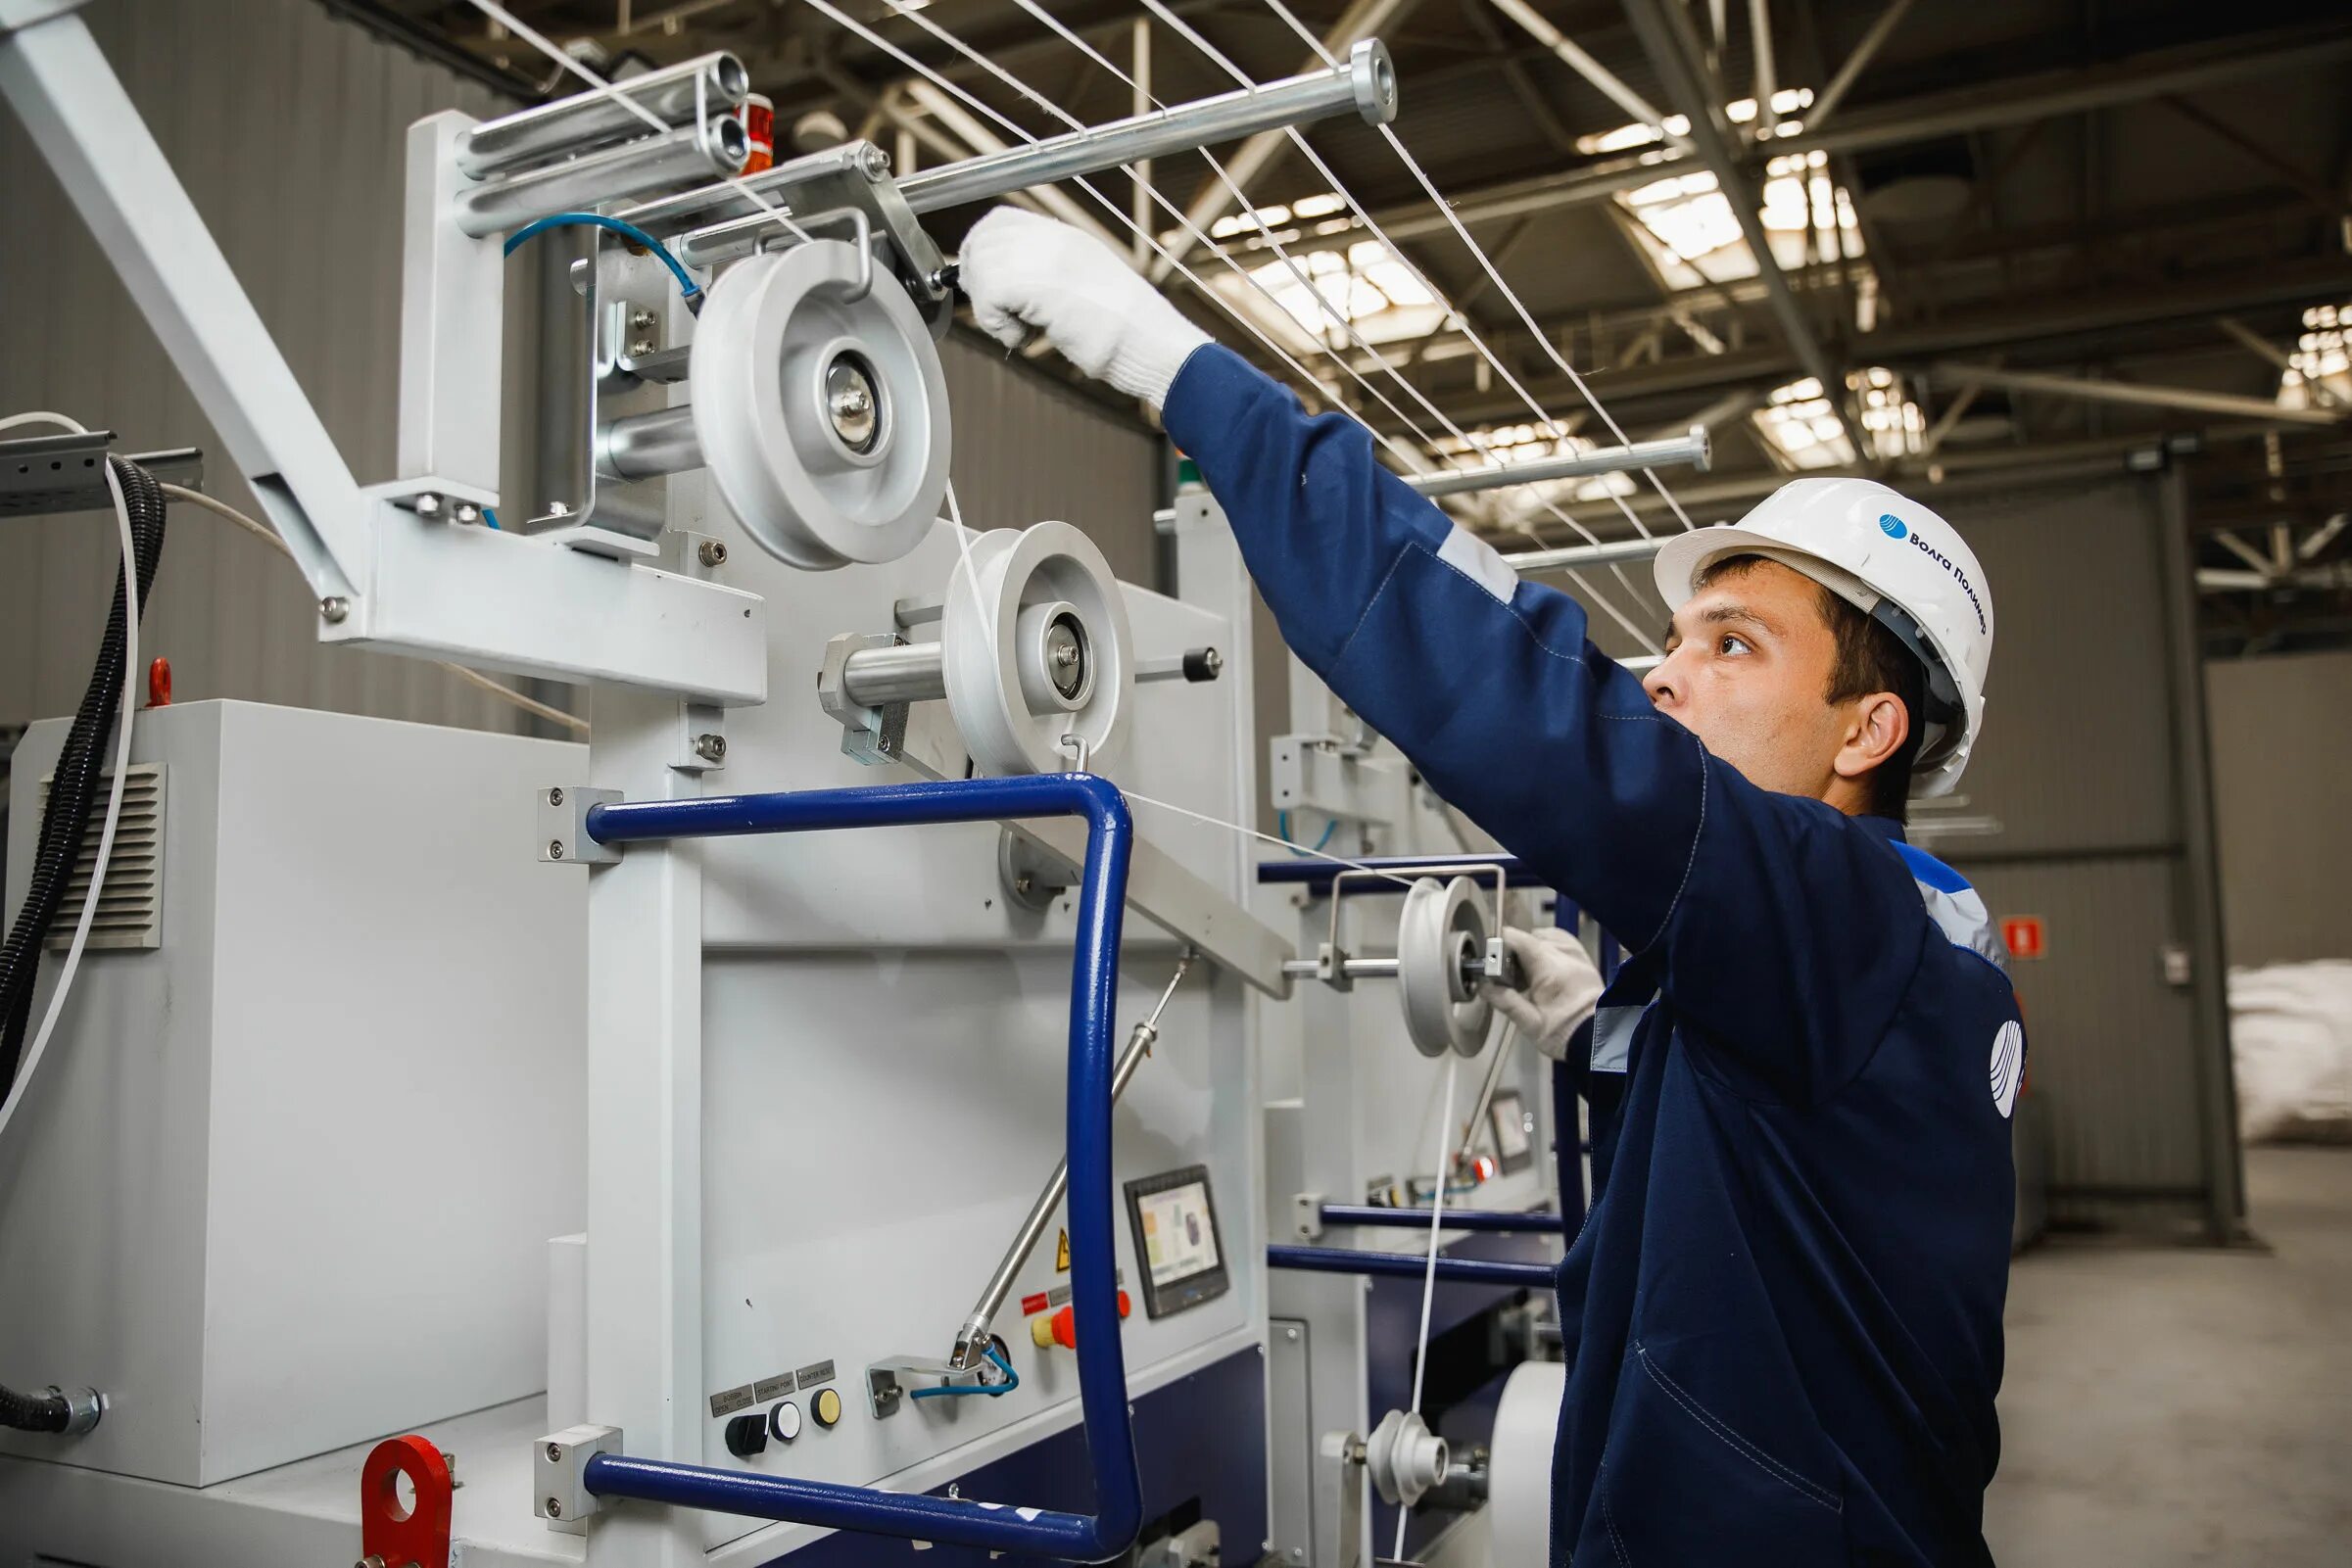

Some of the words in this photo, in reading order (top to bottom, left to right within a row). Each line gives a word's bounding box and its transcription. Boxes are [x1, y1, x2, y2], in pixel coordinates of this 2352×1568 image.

[1909, 533, 1952, 571] Волга
[1953, 567, 1987, 636] Полимер
[736, 1396, 752, 1407] CLOSE
